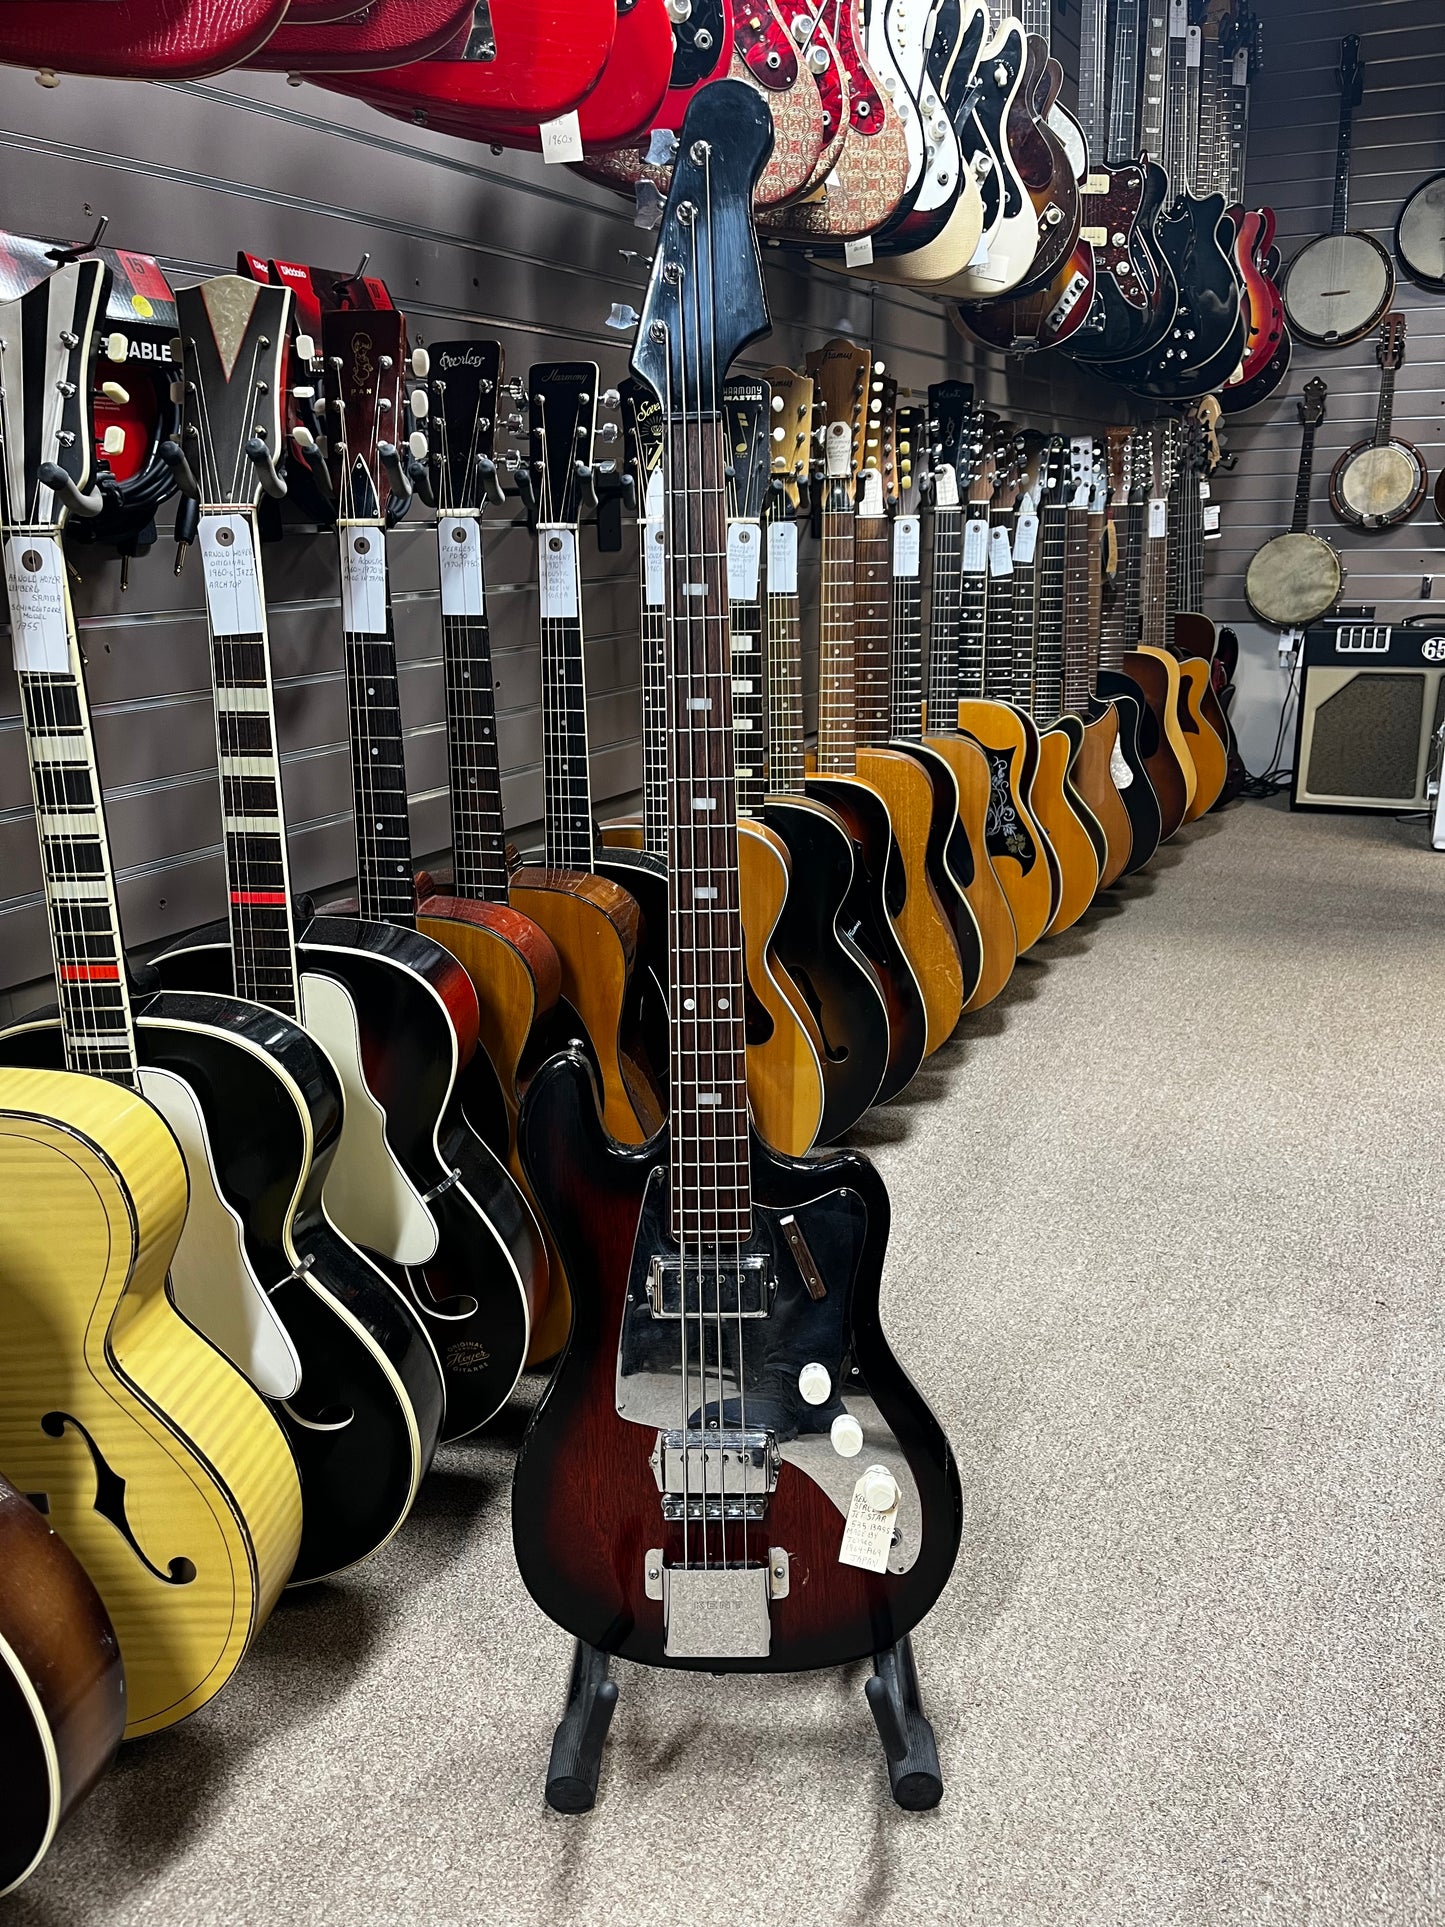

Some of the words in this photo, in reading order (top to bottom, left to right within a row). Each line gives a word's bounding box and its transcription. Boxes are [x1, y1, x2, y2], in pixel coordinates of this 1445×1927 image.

[125, 340, 172, 362] ABLE
[439, 348, 486, 370] Peerless
[541, 369, 588, 384] Harmony
[723, 385, 762, 394] HARMONY
[938, 388, 961, 398] Kent
[204, 550, 230, 558] ARNOLD
[210, 559, 246, 567] ORIGINAL
[40, 575, 61, 584] HOYER
[447, 1341, 484, 1352] ORIGINAL
[452, 1361, 489, 1372] GITARRE
[867, 1513, 887, 1522] STAR
[870, 1524, 890, 1534] BASS
[694, 1600, 743, 1610] KENT
